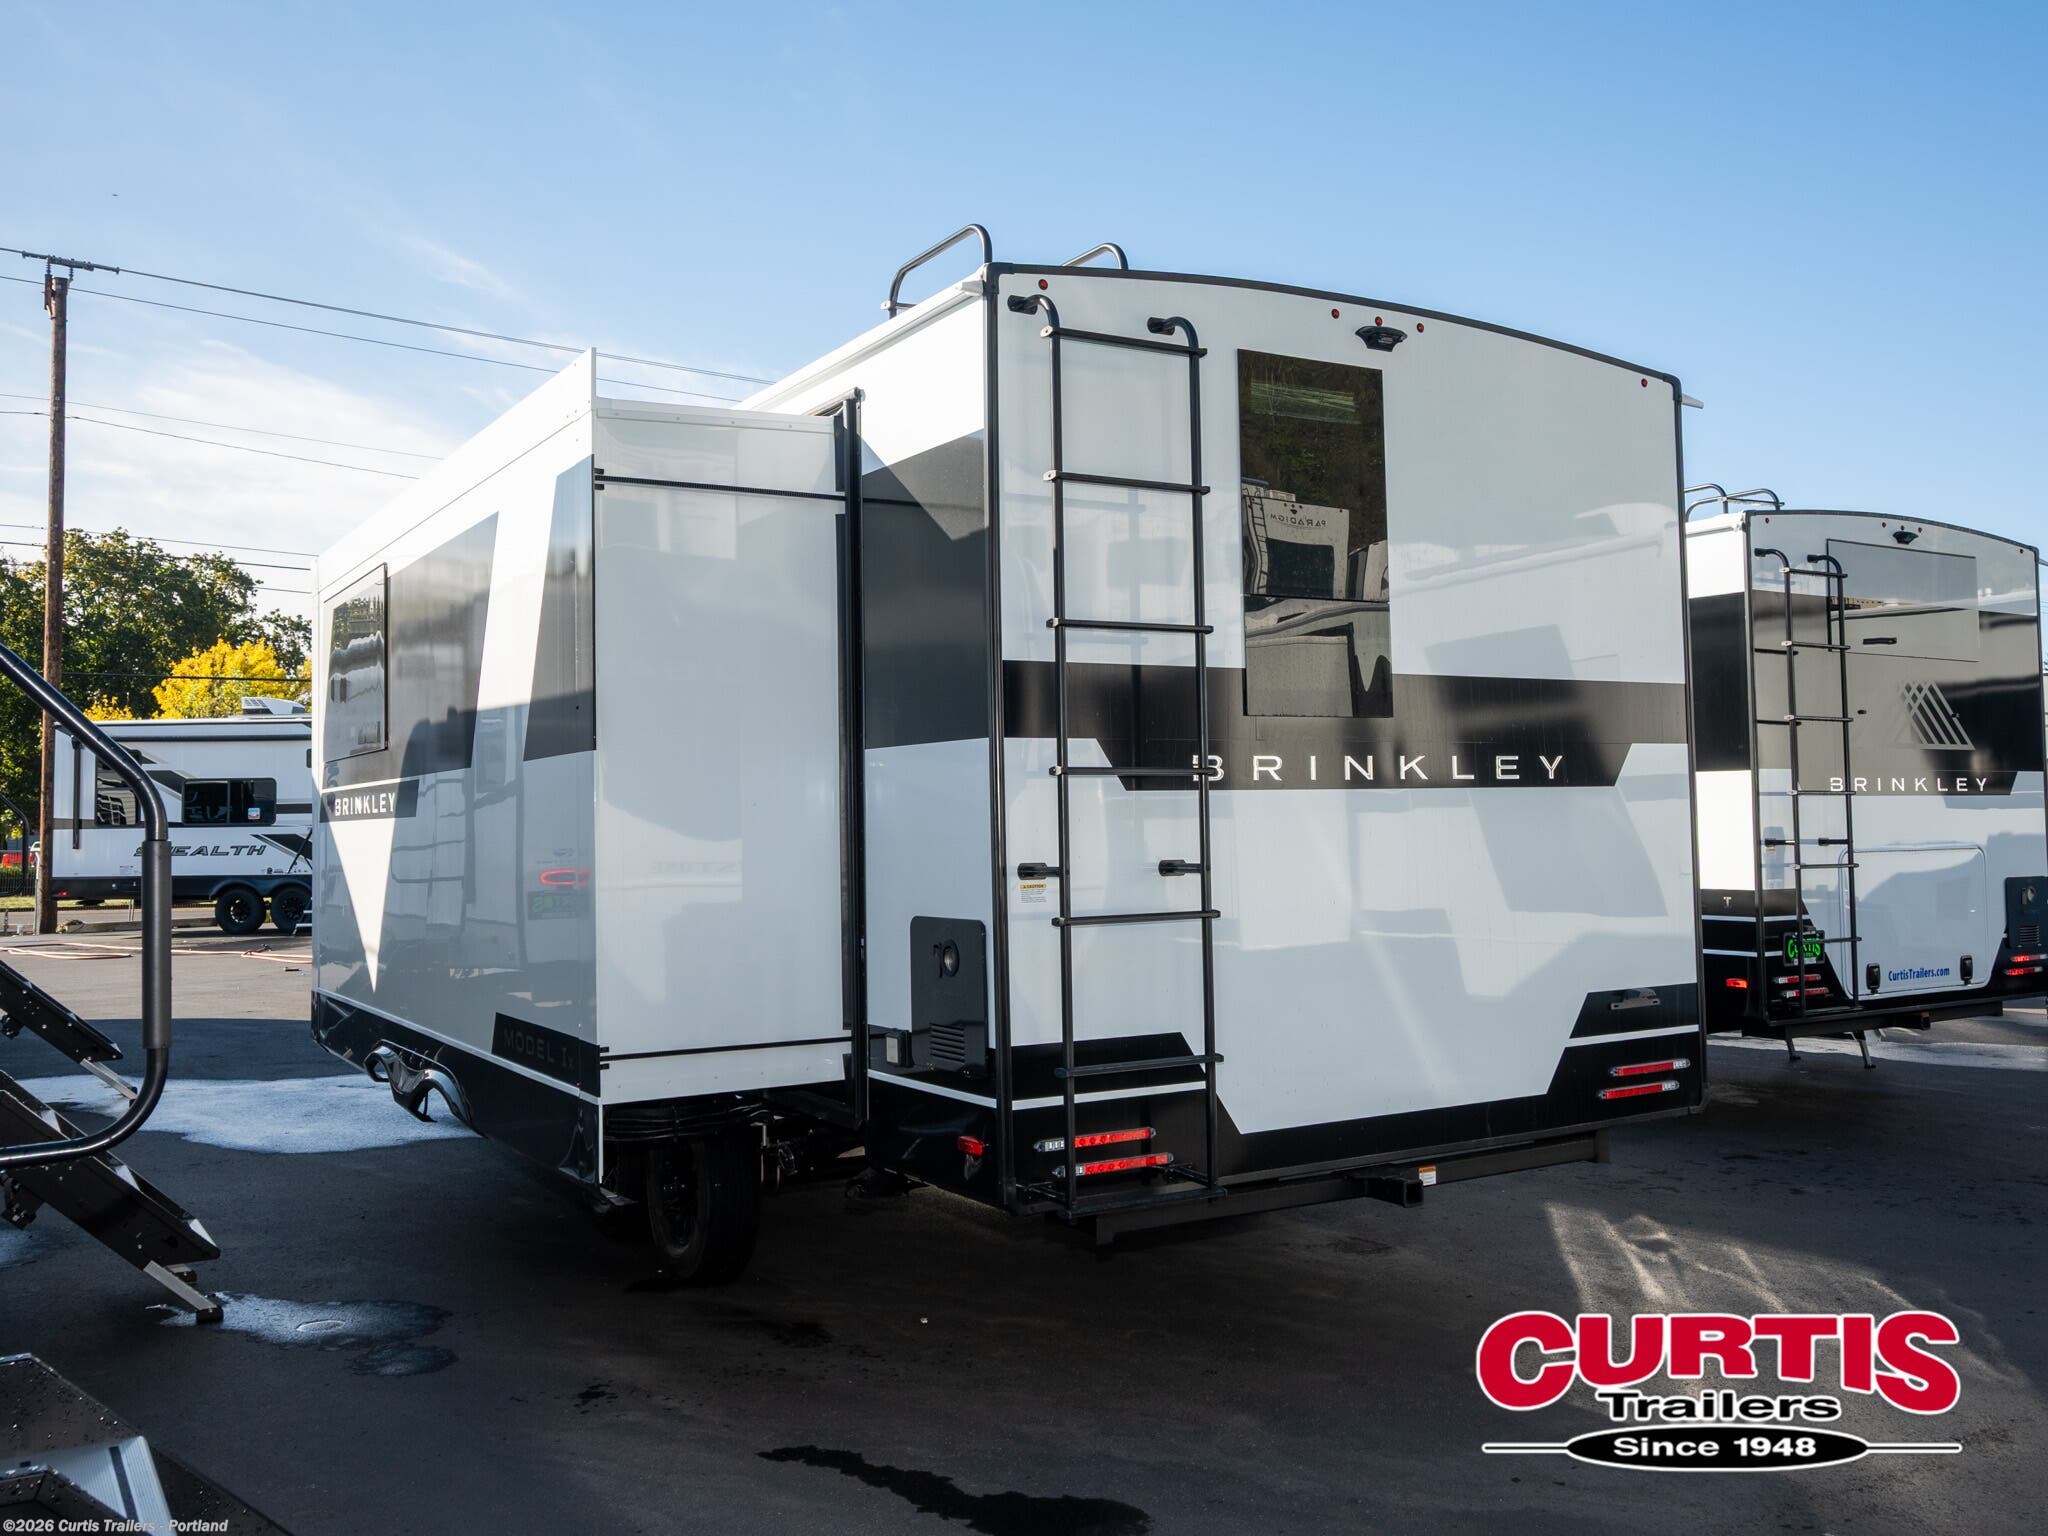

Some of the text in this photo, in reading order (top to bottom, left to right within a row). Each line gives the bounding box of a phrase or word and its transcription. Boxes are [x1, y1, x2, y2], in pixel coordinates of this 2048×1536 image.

[1193, 754, 1563, 782] BRINKLEY
[1830, 777, 1988, 792] BRINKLEY
[334, 791, 396, 817] BRINKLEY
[133, 844, 267, 857] SEALTH
[1888, 967, 1950, 982] CurtisTrailers.com
[504, 1026, 556, 1064] MODEL
